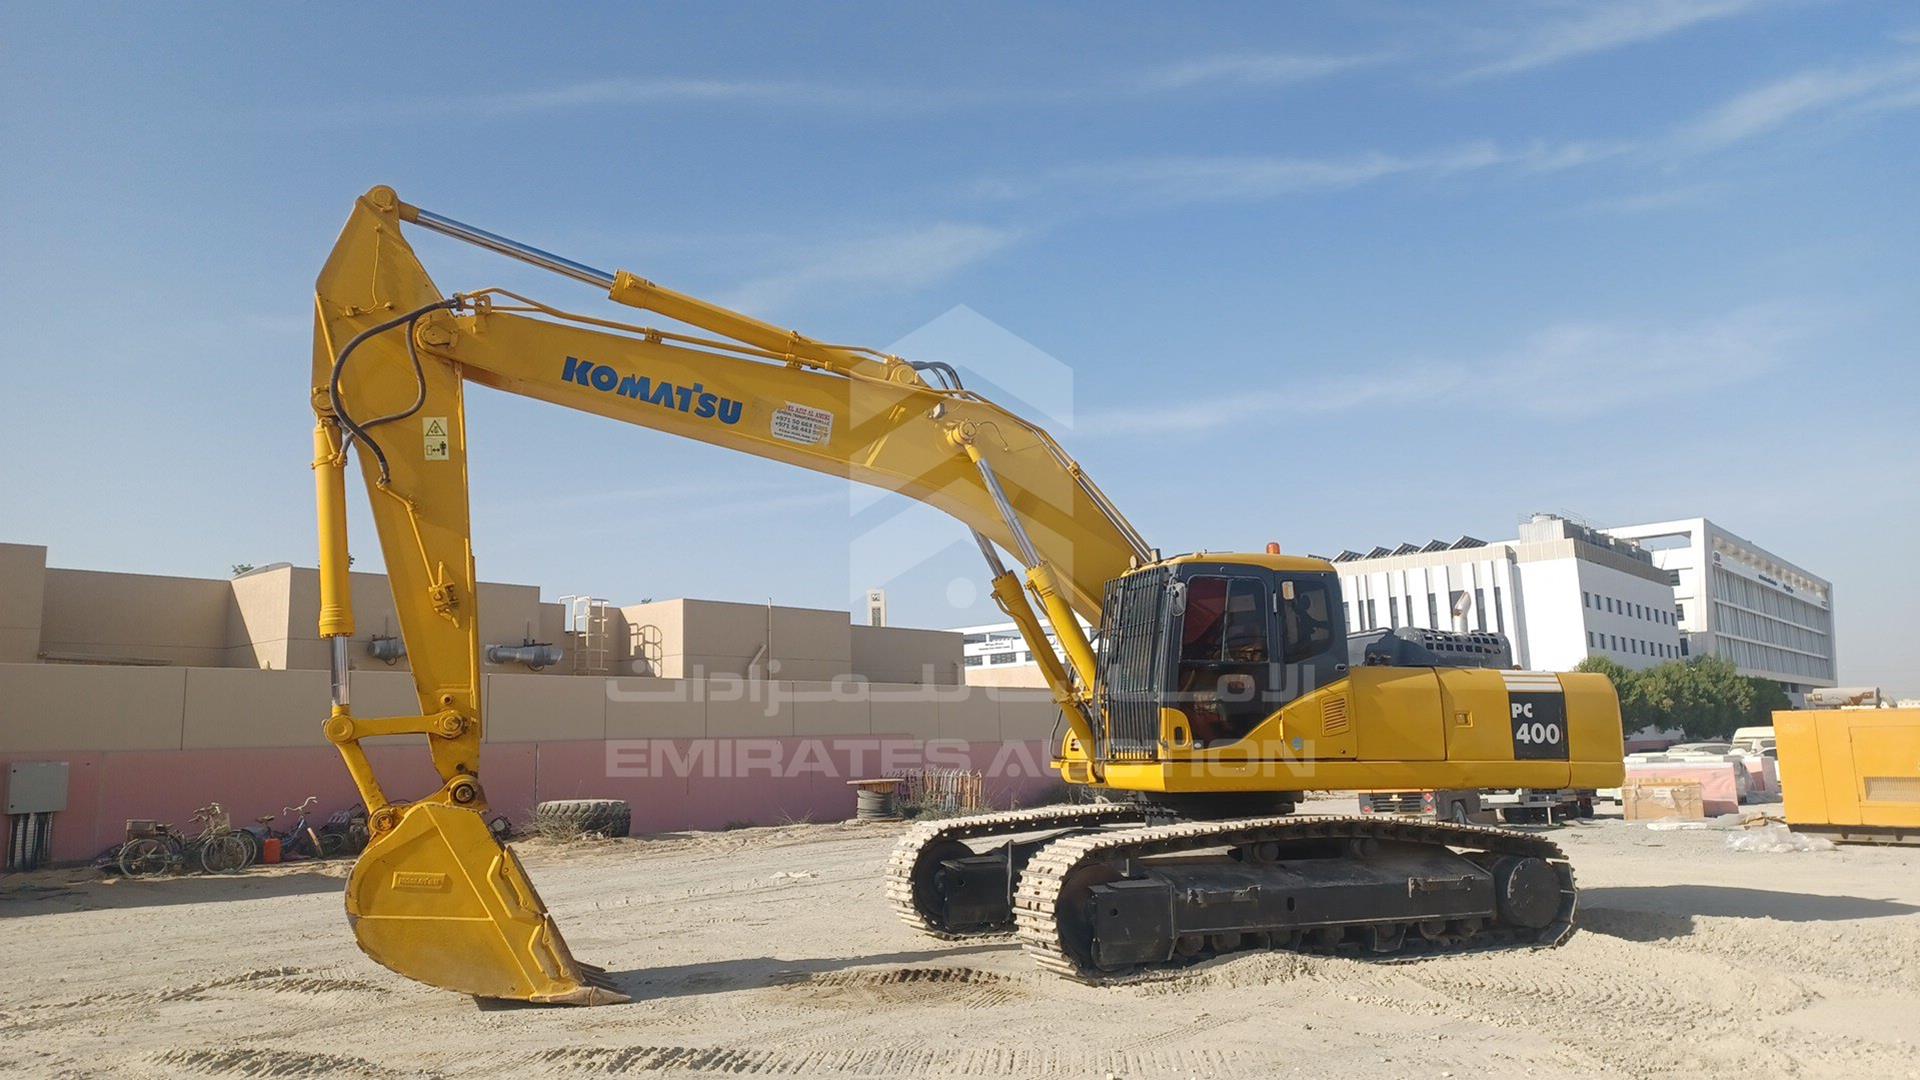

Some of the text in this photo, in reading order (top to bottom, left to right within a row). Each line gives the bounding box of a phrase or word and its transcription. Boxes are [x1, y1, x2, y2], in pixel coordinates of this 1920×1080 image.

[561, 356, 742, 425] KOMATSU
[1511, 703, 1533, 719] PC
[1516, 722, 1560, 745] 400
